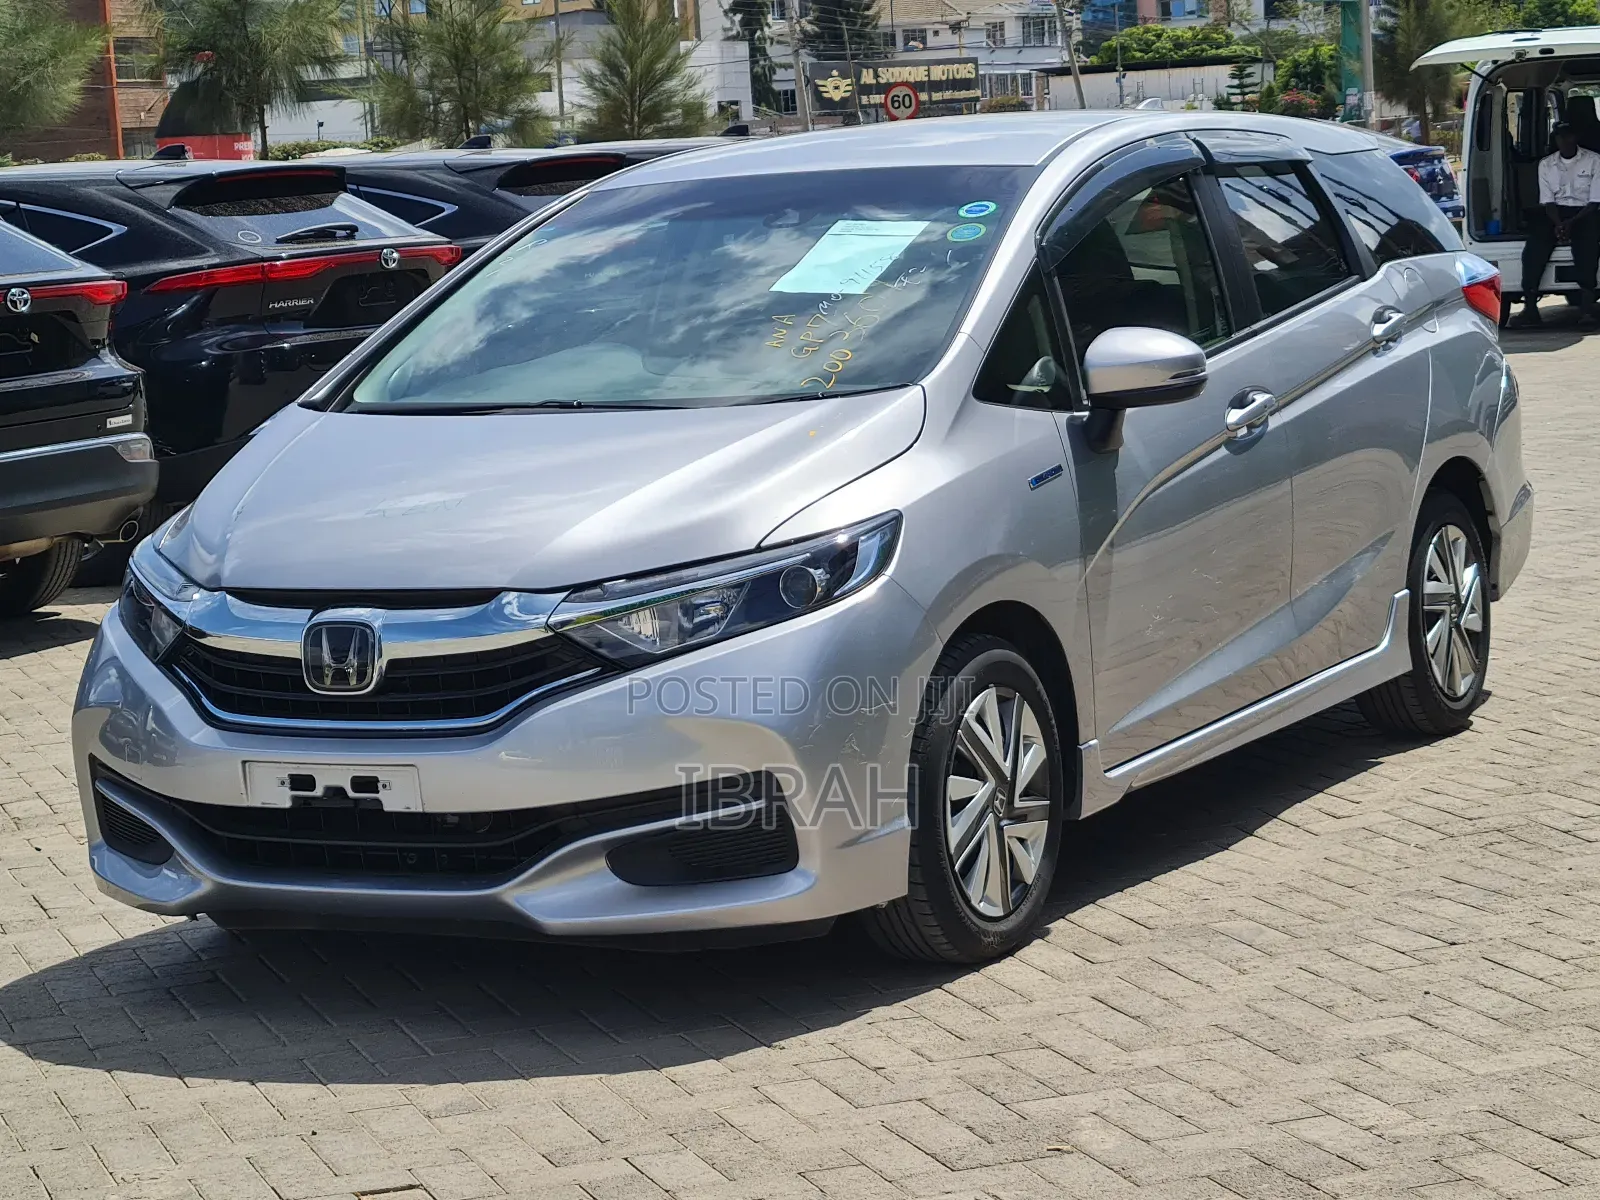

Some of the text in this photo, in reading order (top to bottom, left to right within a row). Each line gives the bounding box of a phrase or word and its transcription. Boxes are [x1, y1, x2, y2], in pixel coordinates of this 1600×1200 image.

[861, 69, 876, 84] AL
[929, 63, 975, 80] MOTORS
[890, 93, 912, 109] 60
[268, 297, 314, 309] HARRIER
